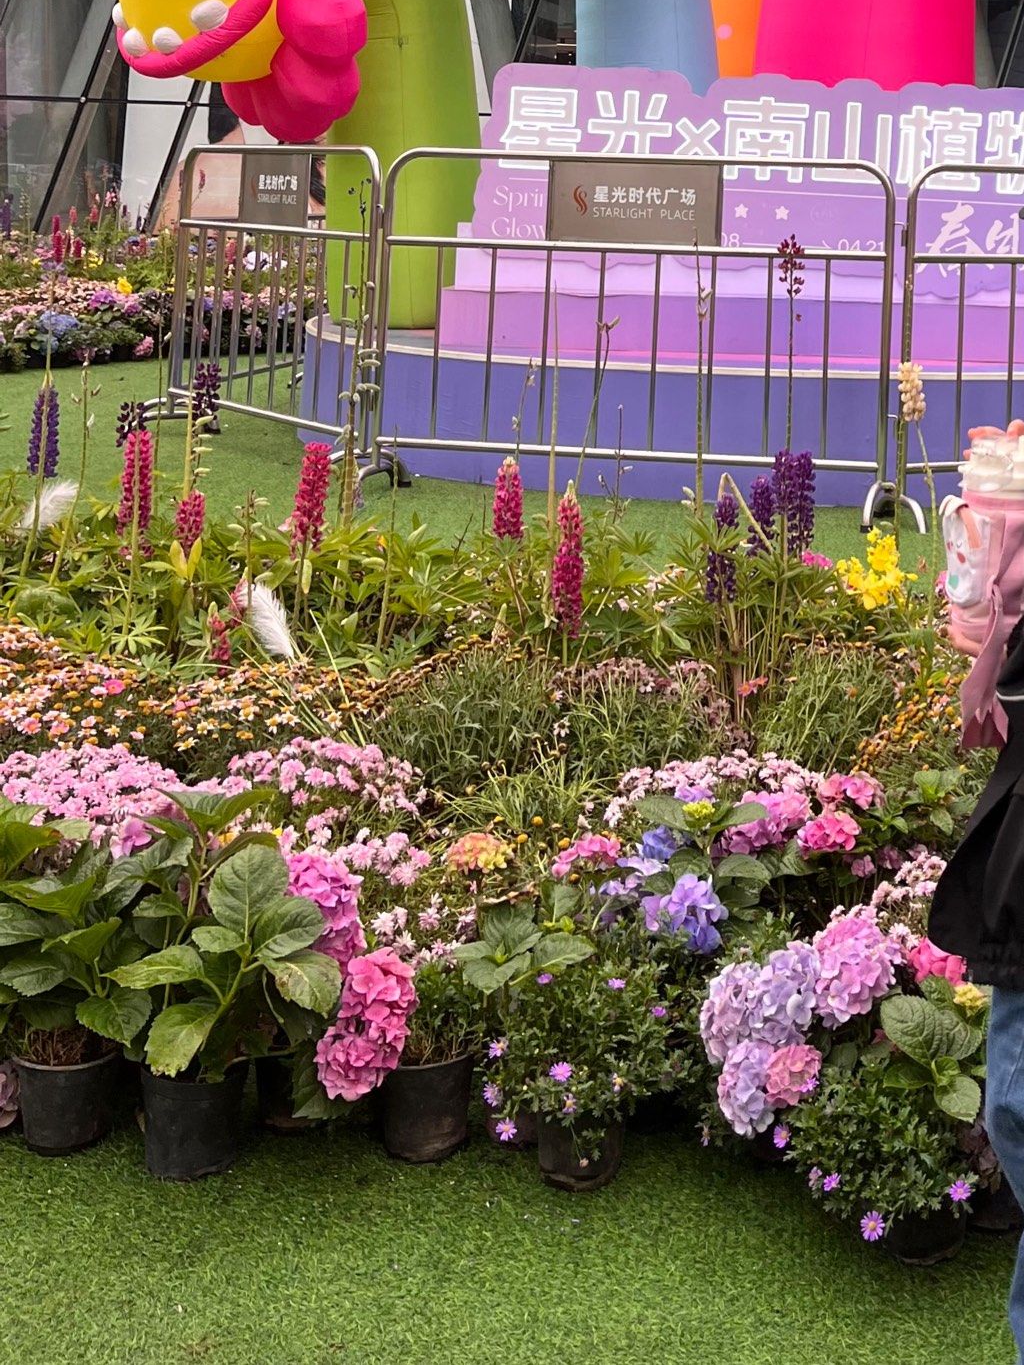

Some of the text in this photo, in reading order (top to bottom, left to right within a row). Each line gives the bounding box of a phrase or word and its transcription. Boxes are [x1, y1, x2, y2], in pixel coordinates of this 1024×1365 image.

[258, 174, 298, 191] 星光时代广场
[593, 185, 696, 206] 星光时代广场
[592, 206, 696, 221] STARLIGHT PLACE
